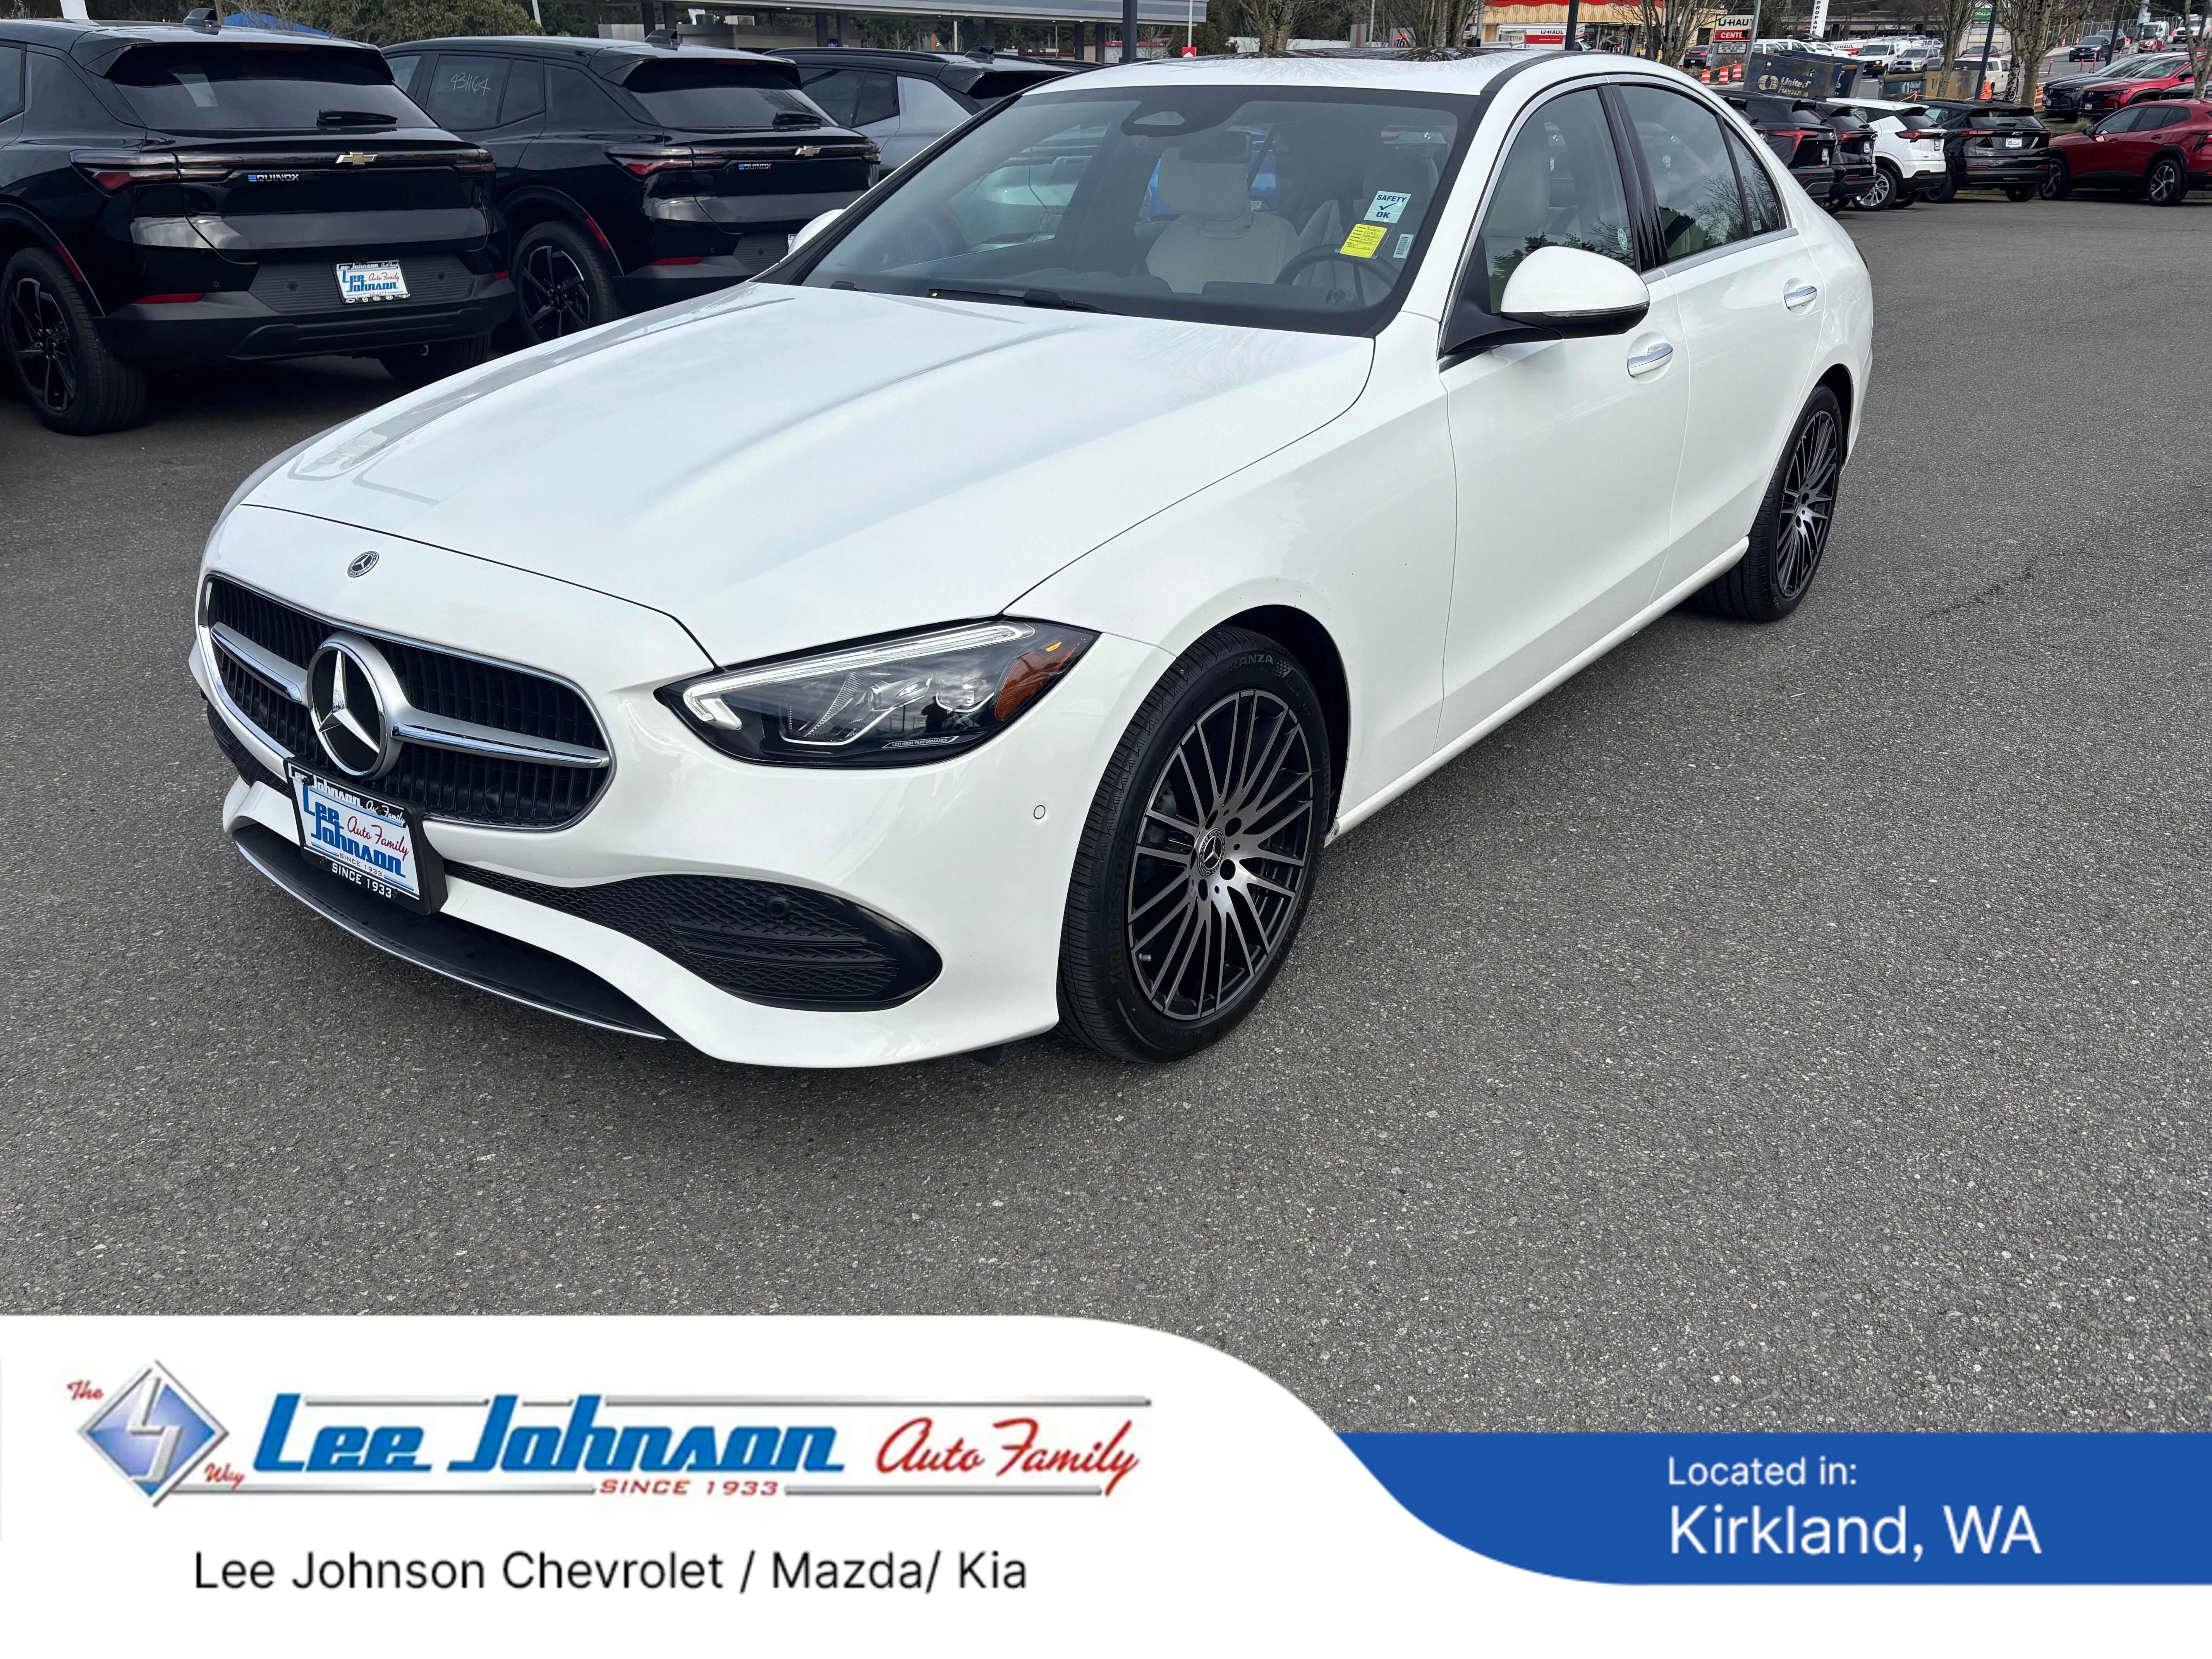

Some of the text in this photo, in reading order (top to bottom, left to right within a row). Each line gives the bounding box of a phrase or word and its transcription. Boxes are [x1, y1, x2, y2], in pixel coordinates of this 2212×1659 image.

[1812, 1, 1821, 34] PROPANE
[450, 72, 491, 95] 431164
[1781, 77, 1811, 88] United
[1376, 194, 1407, 203] SAFETY
[343, 270, 399, 283] Lee Auto Family
[347, 280, 398, 292] Johnson
[311, 774, 363, 808] Johnson
[381, 805, 405, 827] Family
[303, 784, 409, 861] Lee Auto Family
[311, 818, 406, 878] Johnson
[340, 853, 382, 877] SINCE 1933
[332, 862, 392, 898] SINCE 1933
